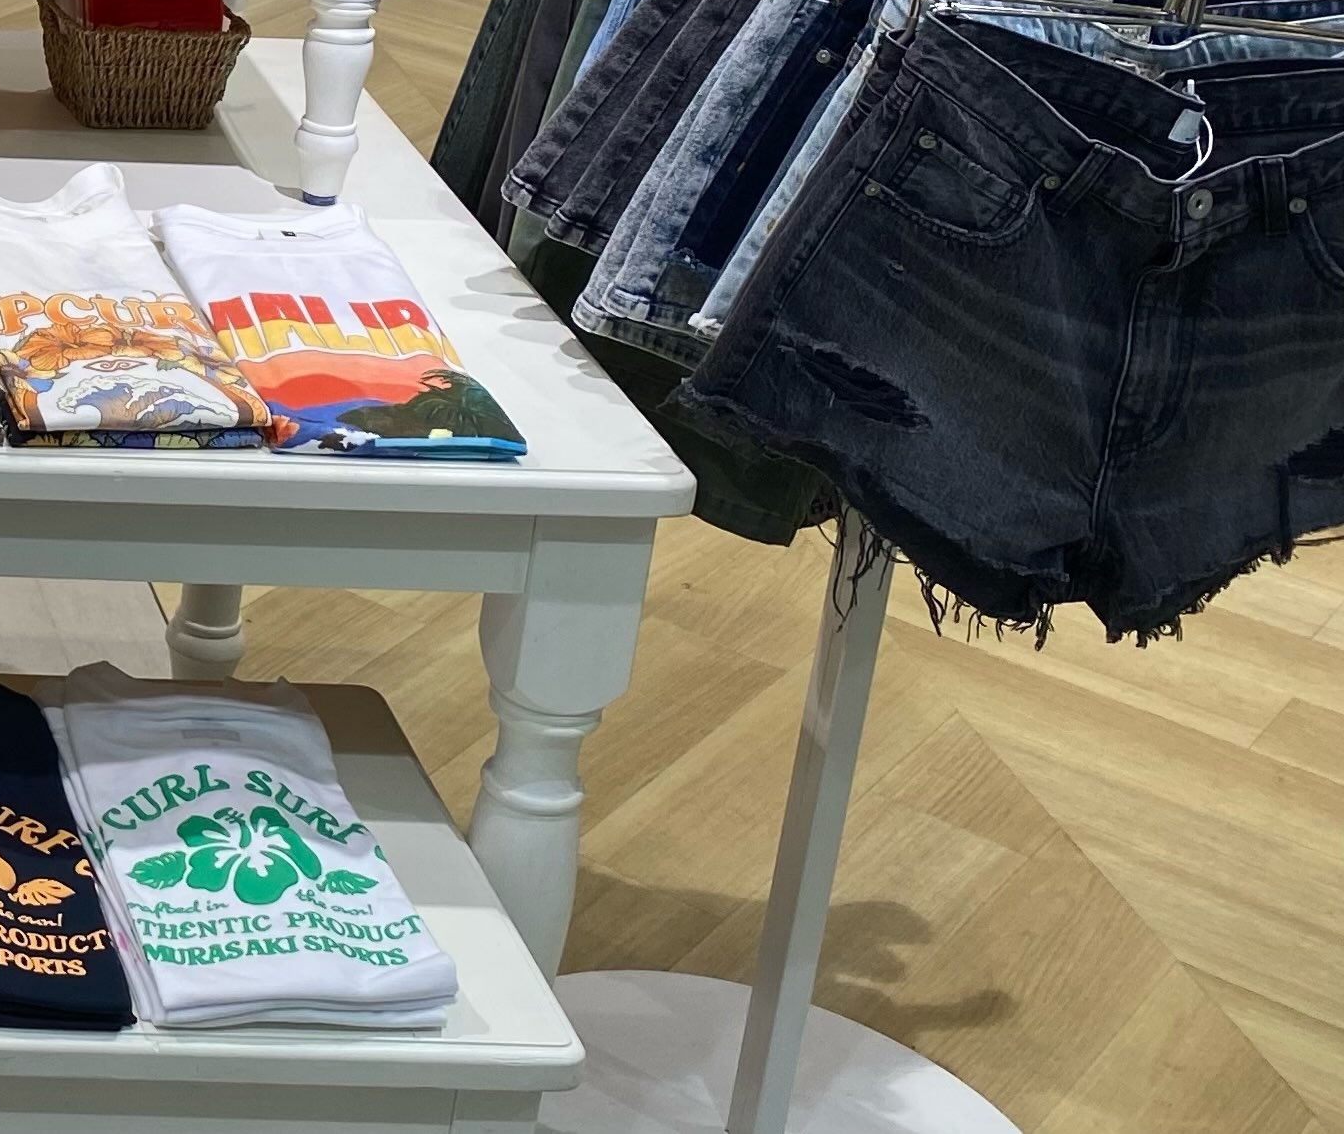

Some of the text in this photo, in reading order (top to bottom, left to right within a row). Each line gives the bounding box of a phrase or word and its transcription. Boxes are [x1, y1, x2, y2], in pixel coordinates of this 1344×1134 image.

[102, 764, 231, 831] CURL
[133, 911, 422, 943] THENTIC PRODUCT
[142, 934, 410, 967] MURASAKI SPORTS
